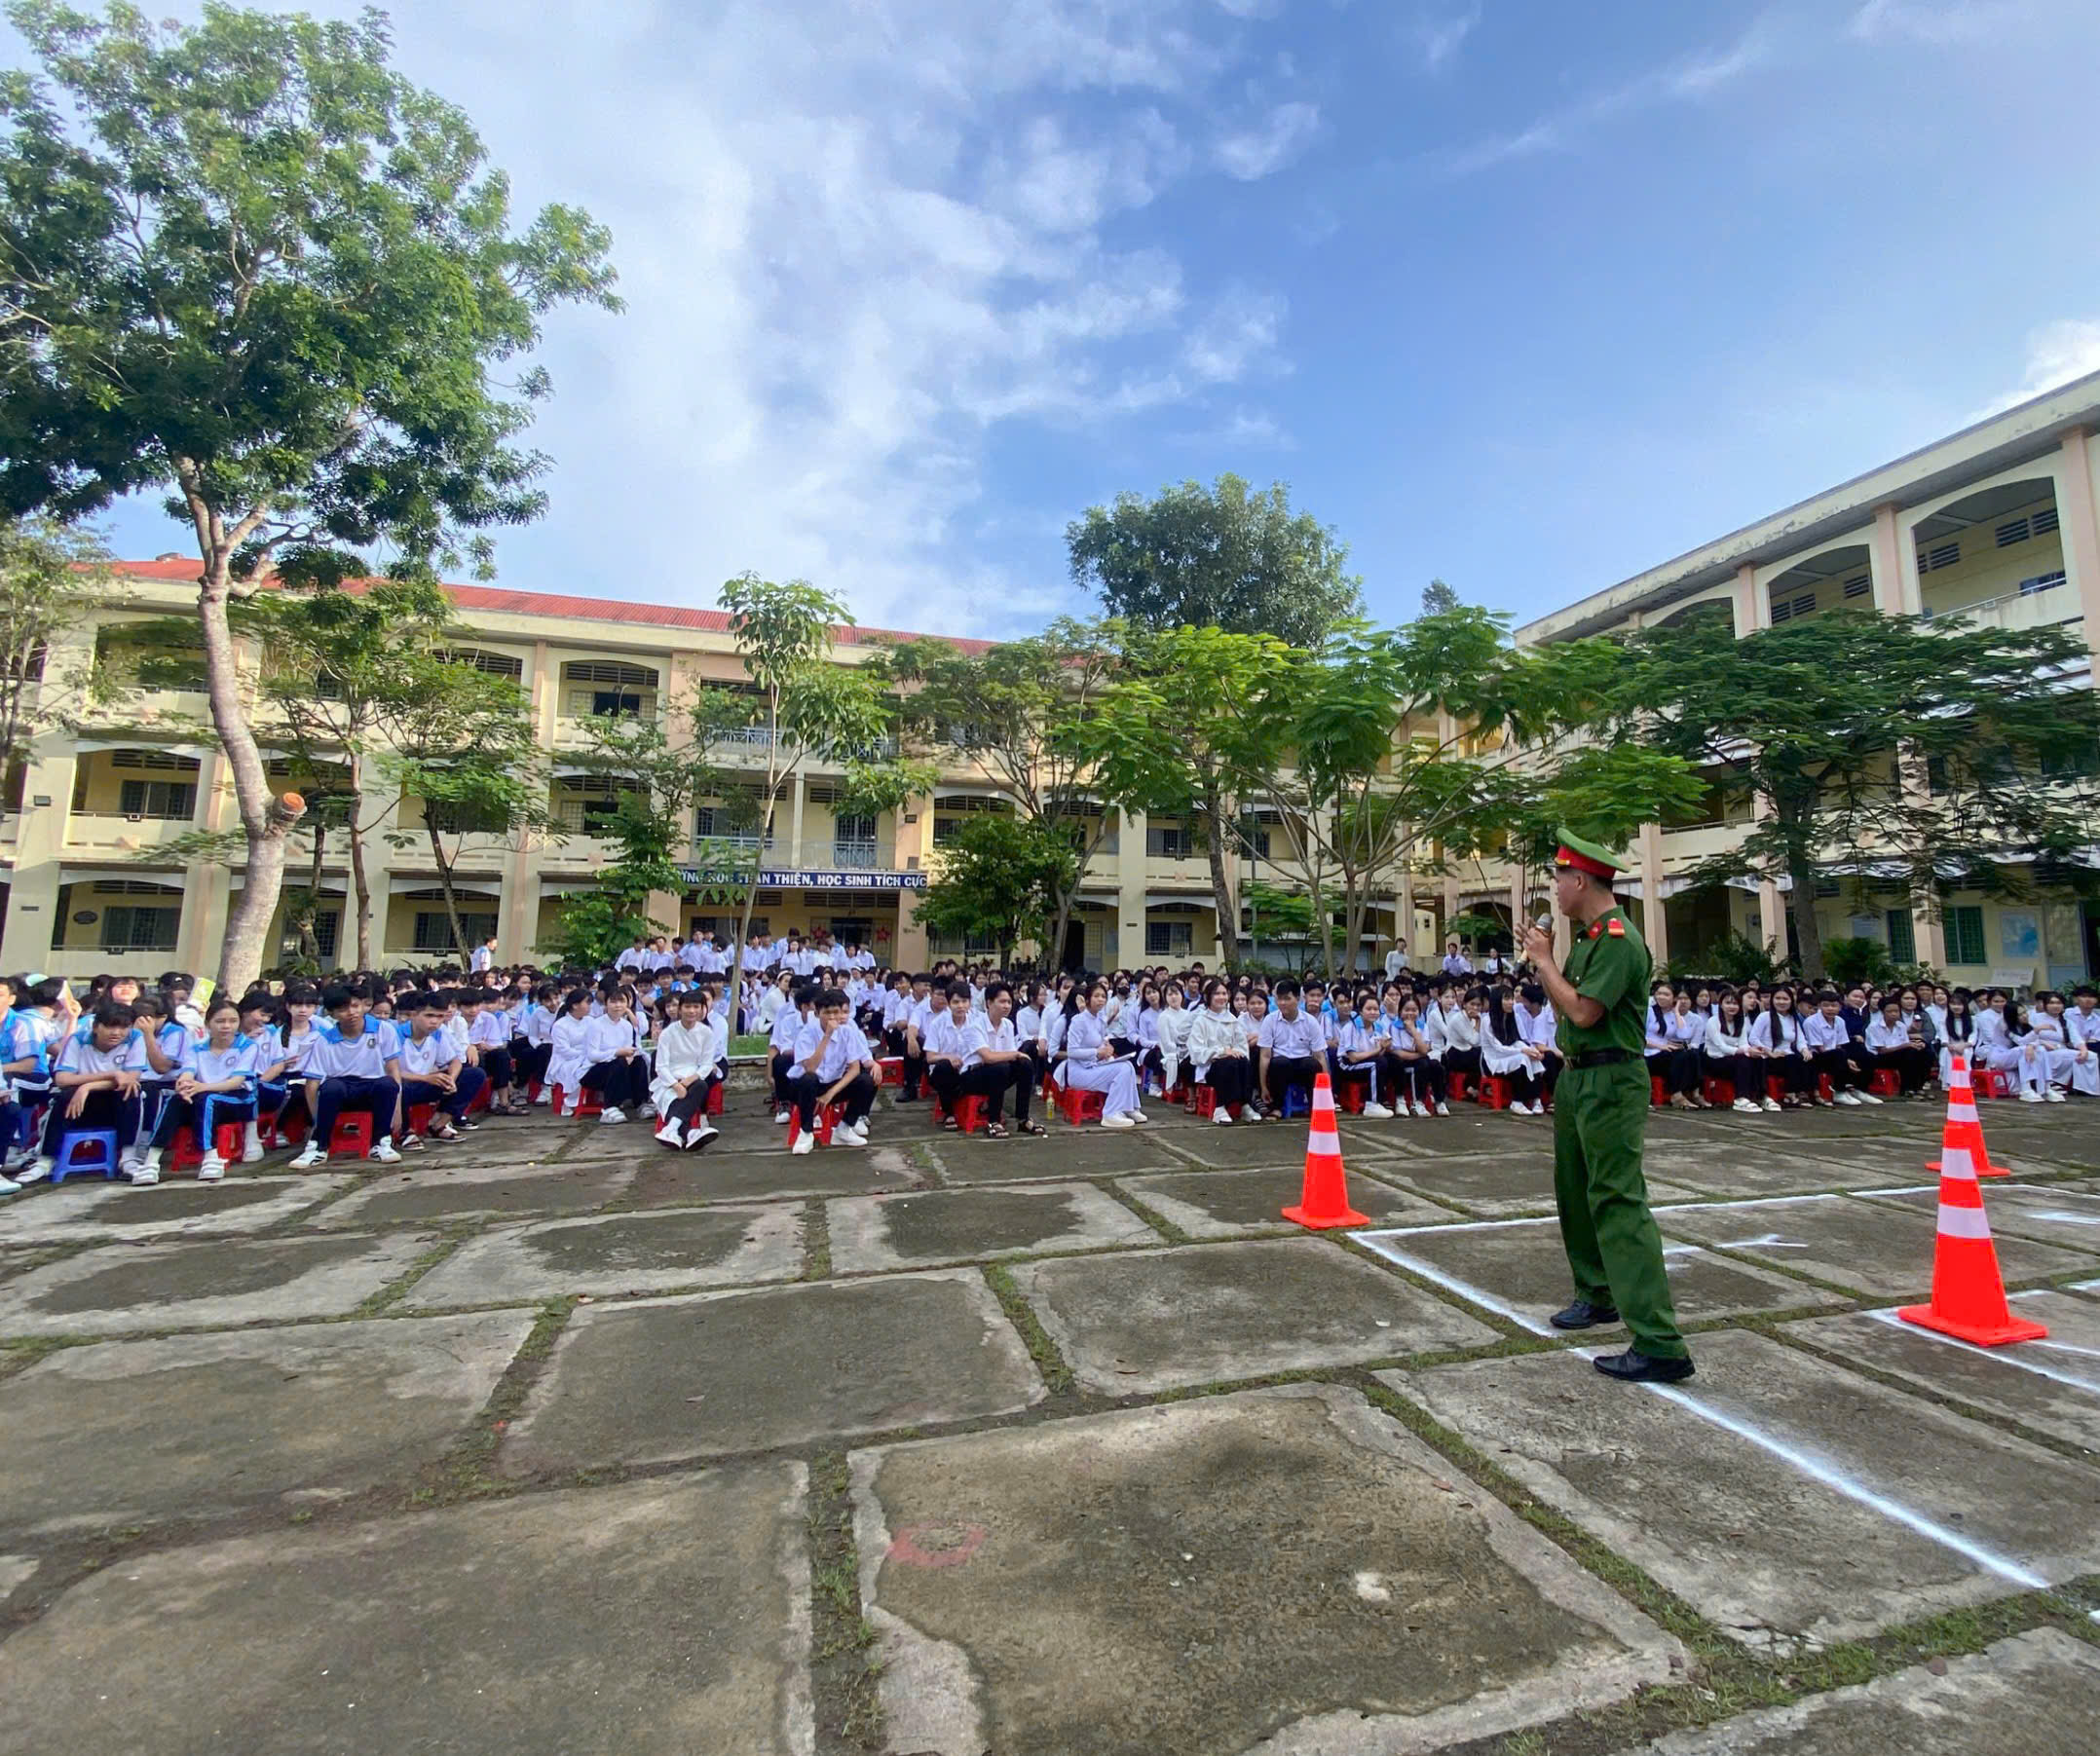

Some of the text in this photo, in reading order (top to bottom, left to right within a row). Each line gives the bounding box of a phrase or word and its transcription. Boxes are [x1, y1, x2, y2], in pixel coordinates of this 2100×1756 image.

[774, 872, 813, 887] THIỆN,
[817, 875, 842, 887] HỌC
[844, 876, 873, 886] SINH
[876, 874, 901, 886] TÍCH
[904, 876, 927, 888] CỰC
